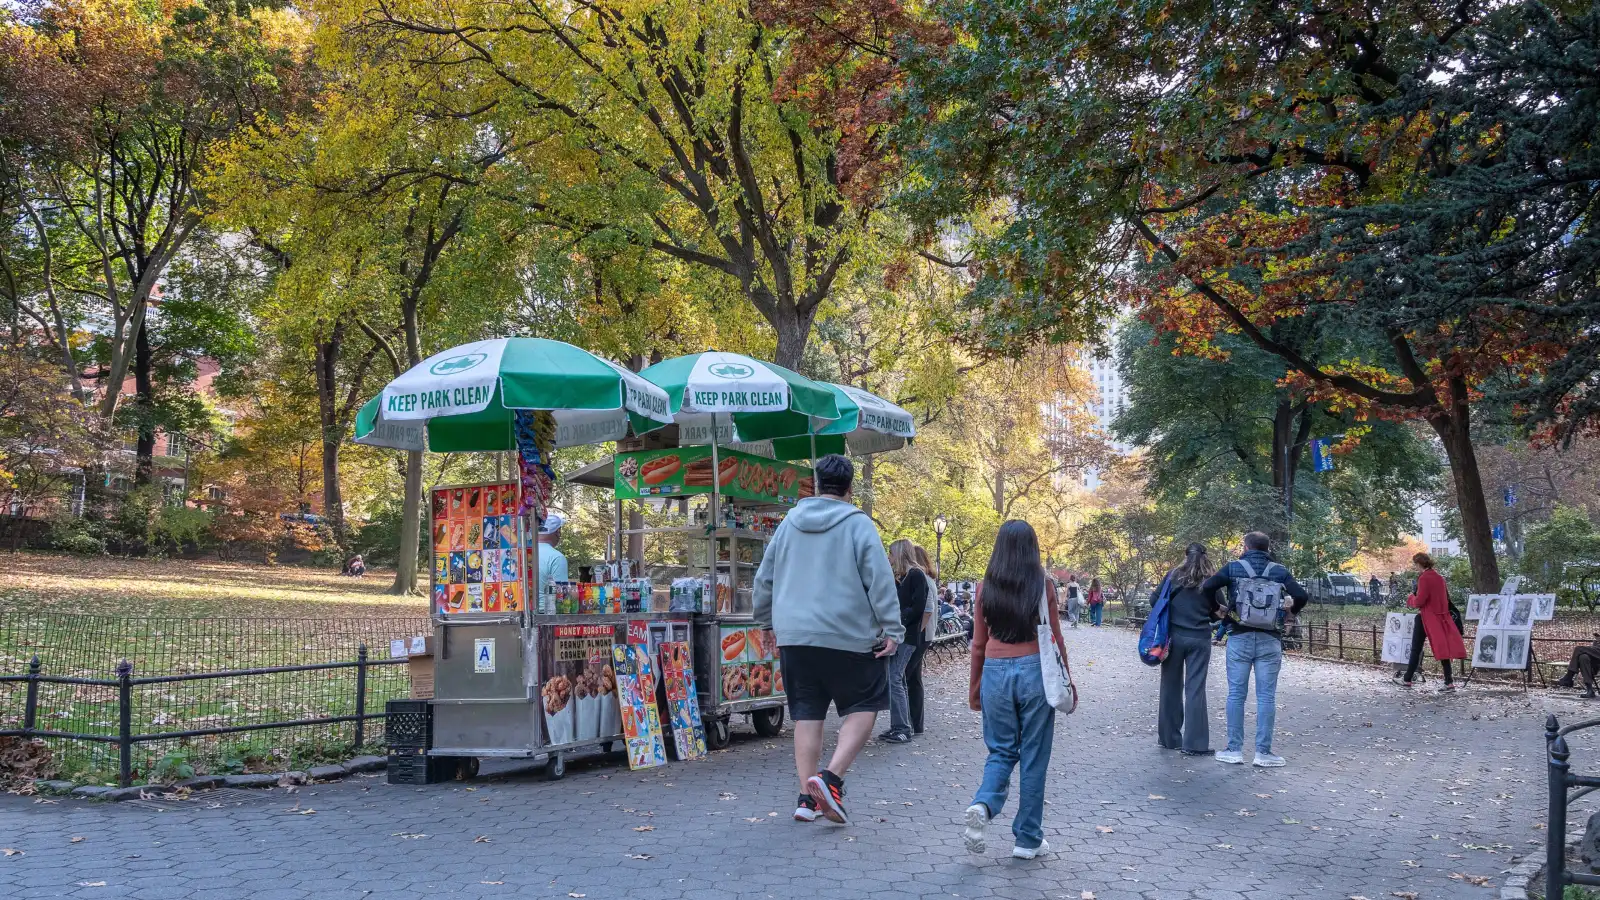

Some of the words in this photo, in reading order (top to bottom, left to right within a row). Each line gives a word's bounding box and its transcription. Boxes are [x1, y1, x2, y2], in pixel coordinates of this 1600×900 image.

[388, 393, 417, 412] KEEP
[421, 390, 450, 410] PARK
[454, 385, 490, 406] CLEAN
[695, 391, 718, 406] KEEP
[722, 391, 749, 406] PARK
[751, 391, 782, 406] CLEAN
[559, 626, 581, 636] HONEY
[559, 639, 584, 650] PEANUT
[479, 645, 490, 661] A
[560, 650, 587, 660] CASHEW
